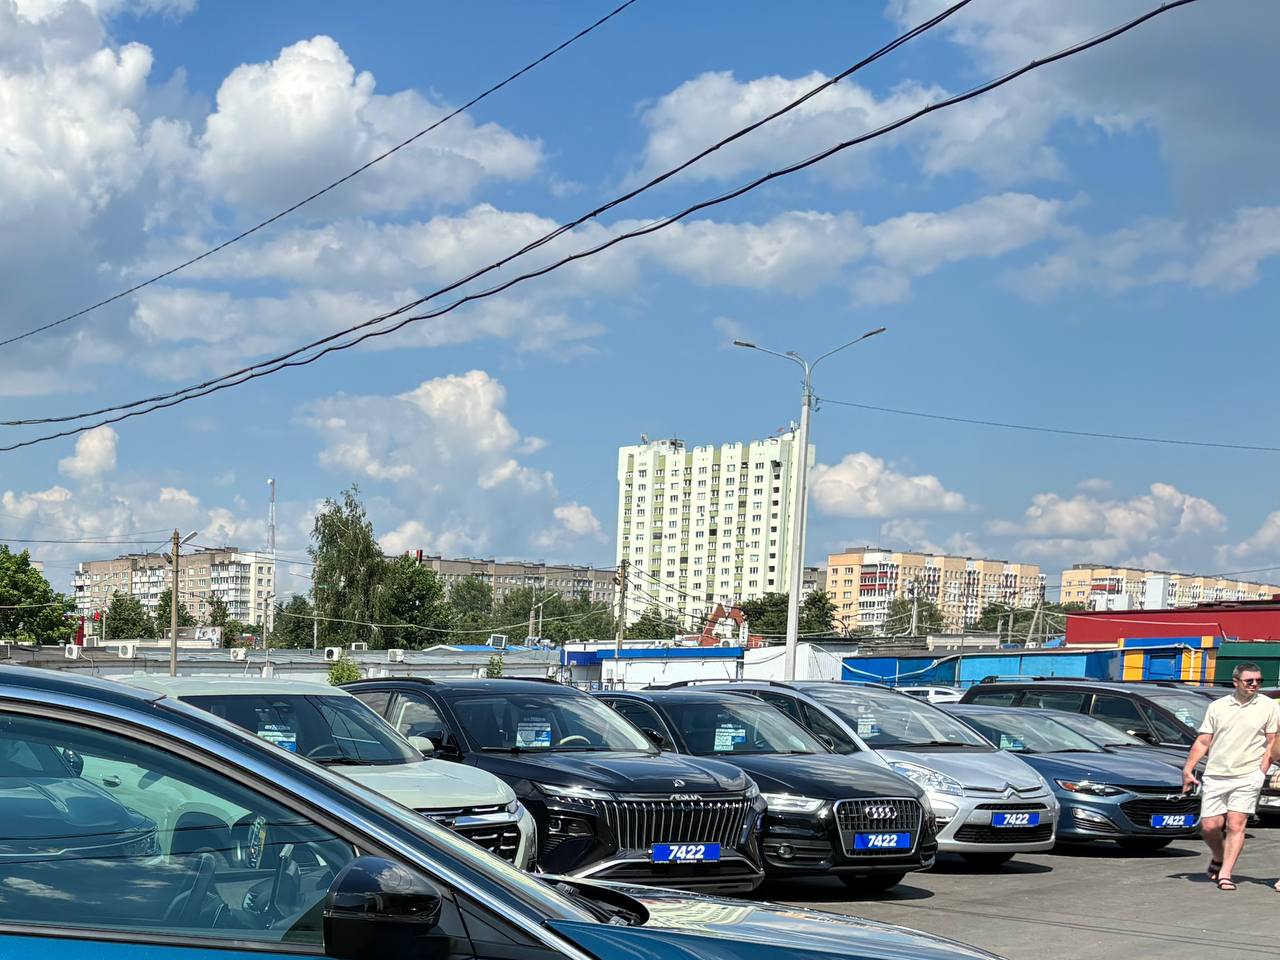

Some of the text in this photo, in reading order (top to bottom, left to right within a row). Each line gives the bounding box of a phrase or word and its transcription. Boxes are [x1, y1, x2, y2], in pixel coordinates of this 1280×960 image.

[1003, 814, 1029, 825] 7422
[1162, 815, 1185, 825] 7422
[867, 834, 897, 847] 7422
[669, 845, 705, 859] 7422
